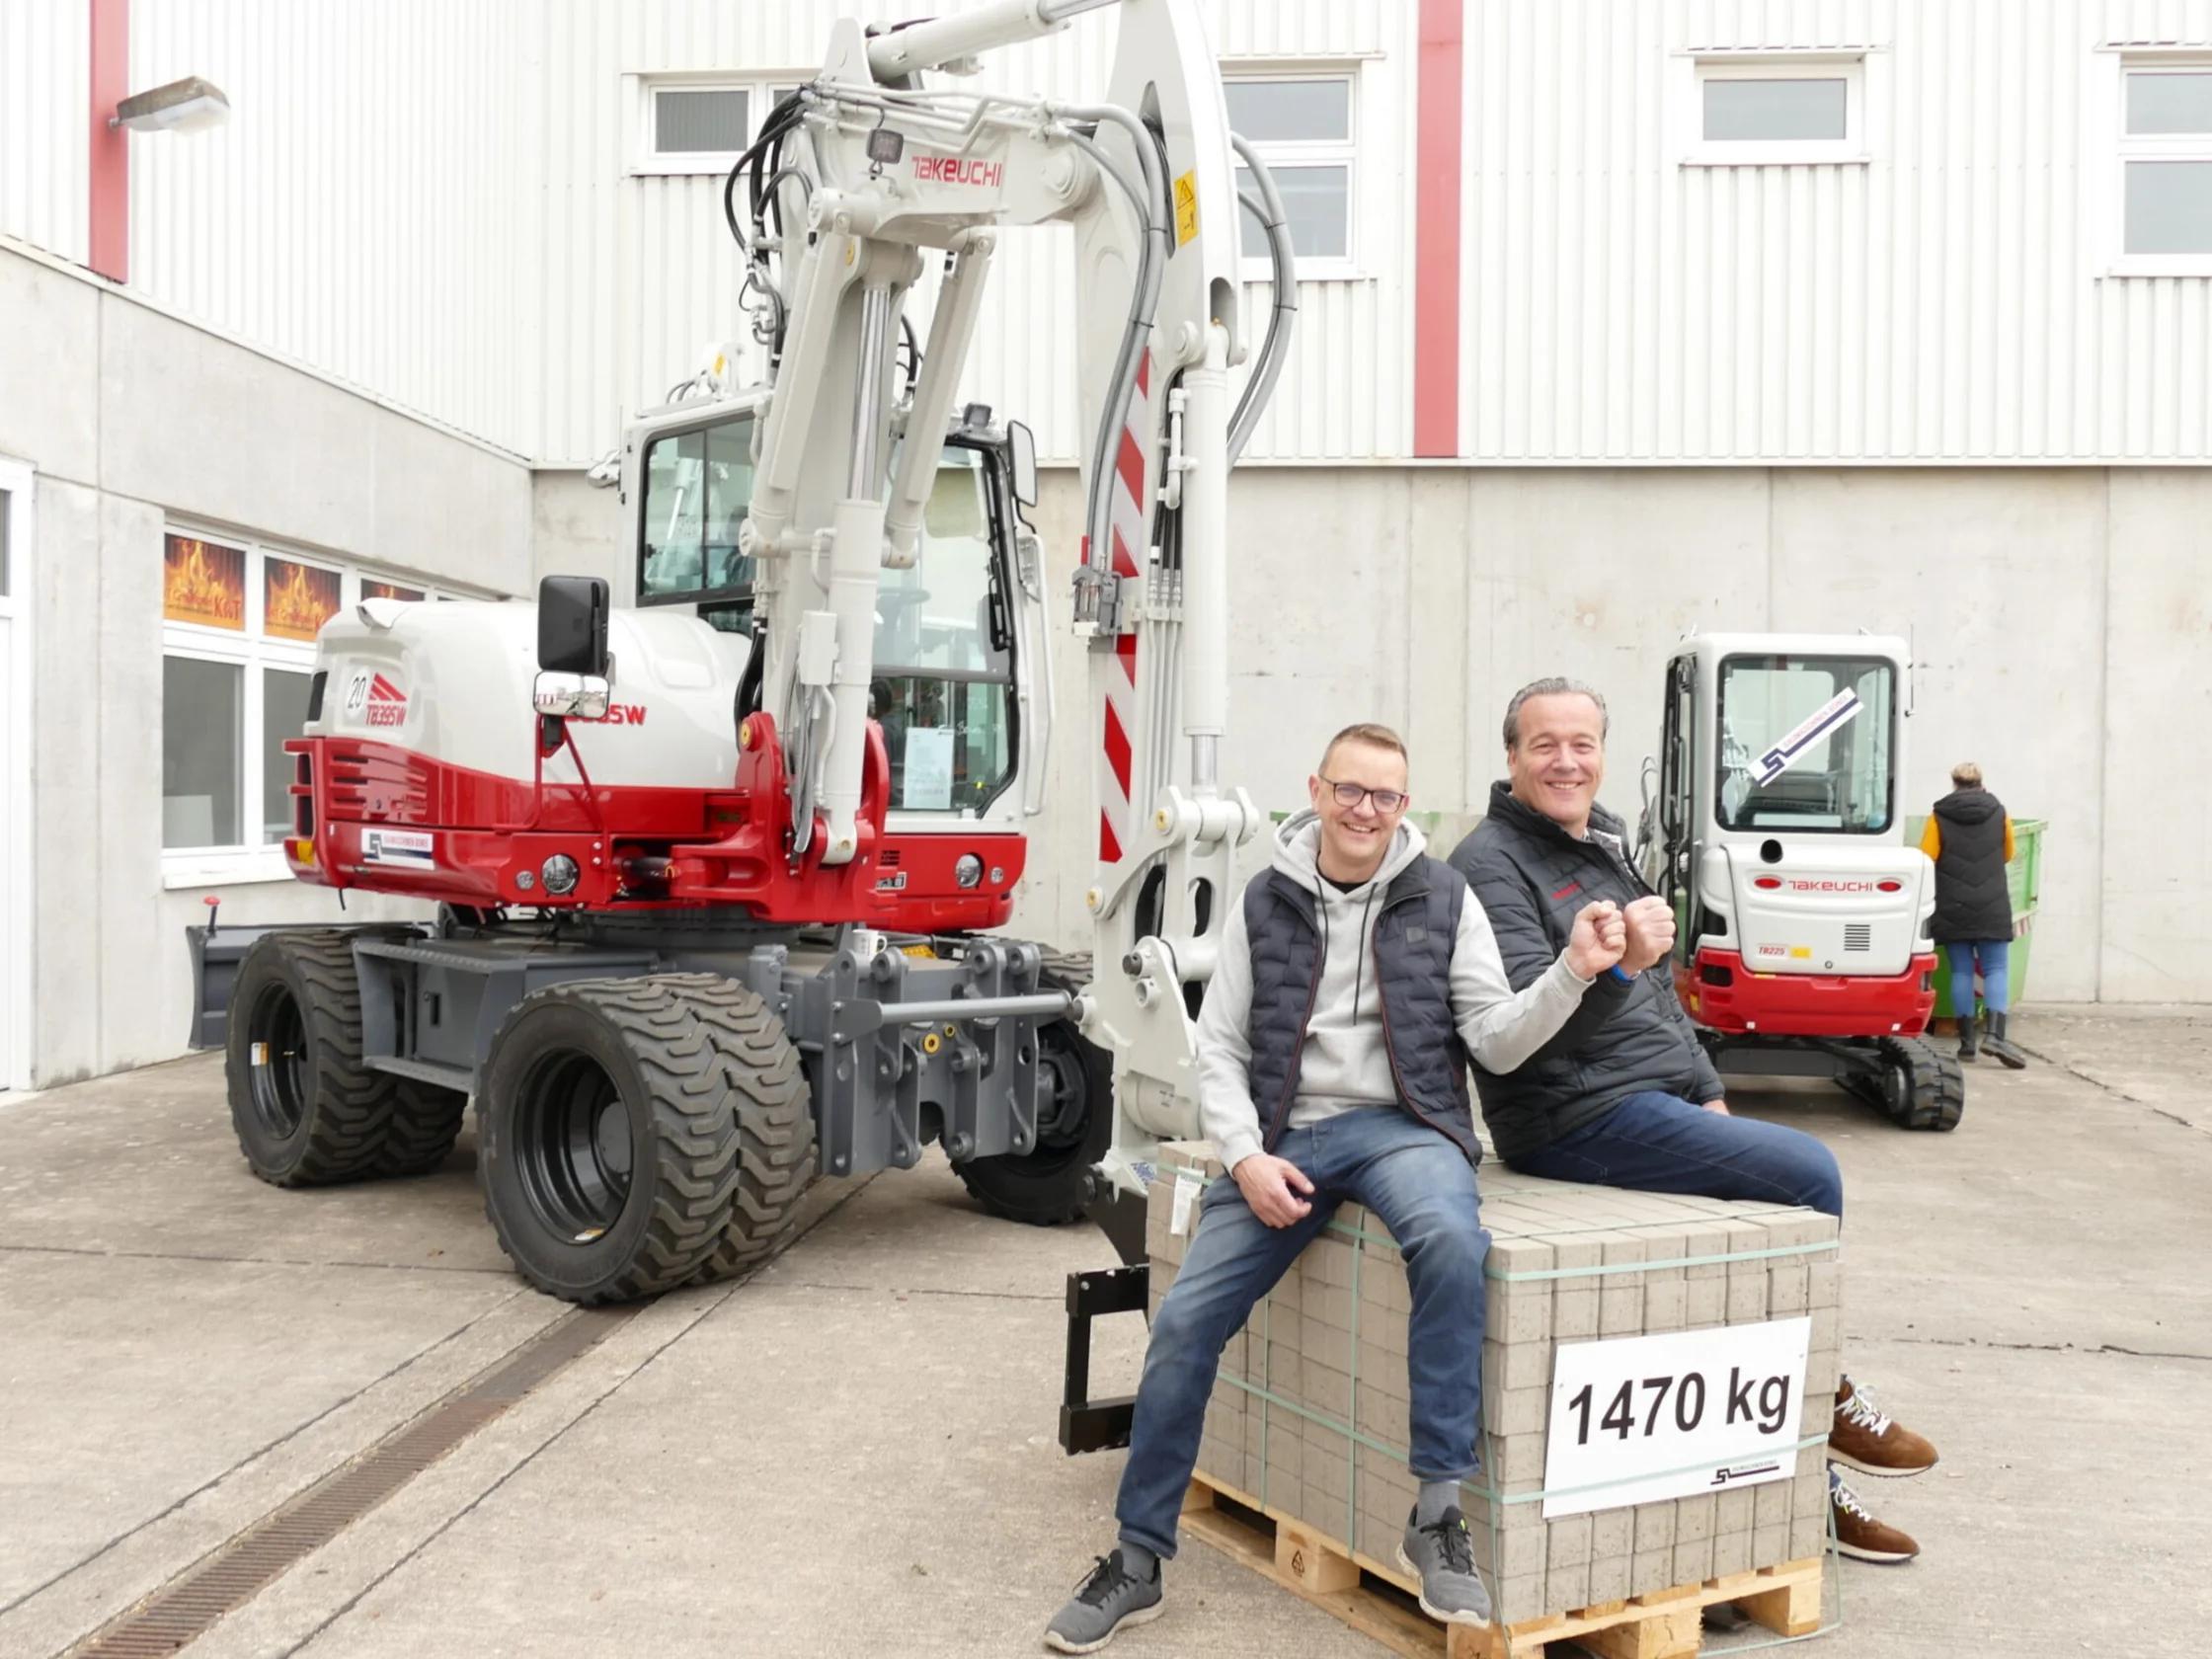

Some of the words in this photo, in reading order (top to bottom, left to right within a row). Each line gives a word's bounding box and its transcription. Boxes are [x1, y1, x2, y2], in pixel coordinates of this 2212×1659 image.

[348, 676, 366, 709] 20
[1568, 1372, 1706, 1446] 1470
[1725, 1366, 1790, 1435] kg
